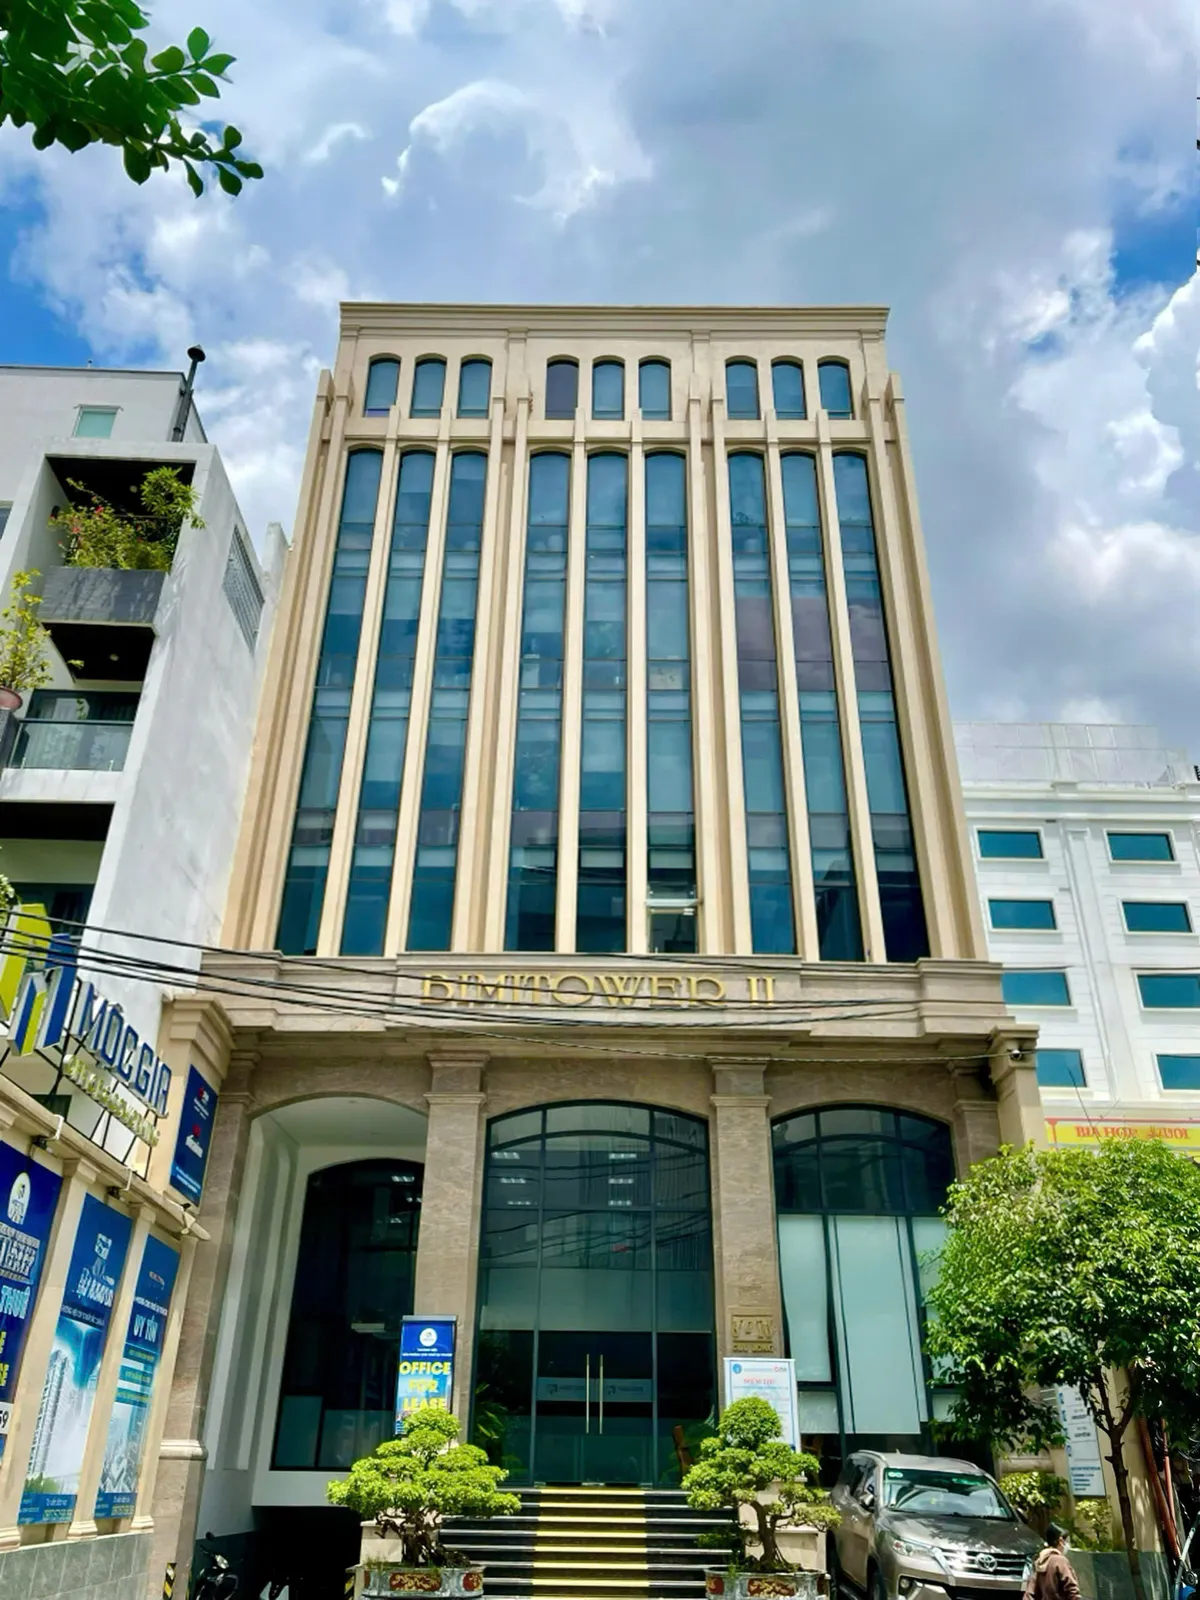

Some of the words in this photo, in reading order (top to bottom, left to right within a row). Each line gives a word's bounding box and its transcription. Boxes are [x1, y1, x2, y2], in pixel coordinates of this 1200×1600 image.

[747, 975, 776, 1006] II
[399, 1361, 452, 1375] OFFICE
[408, 1379, 439, 1393] FOR
[402, 1397, 447, 1411] LEASE
